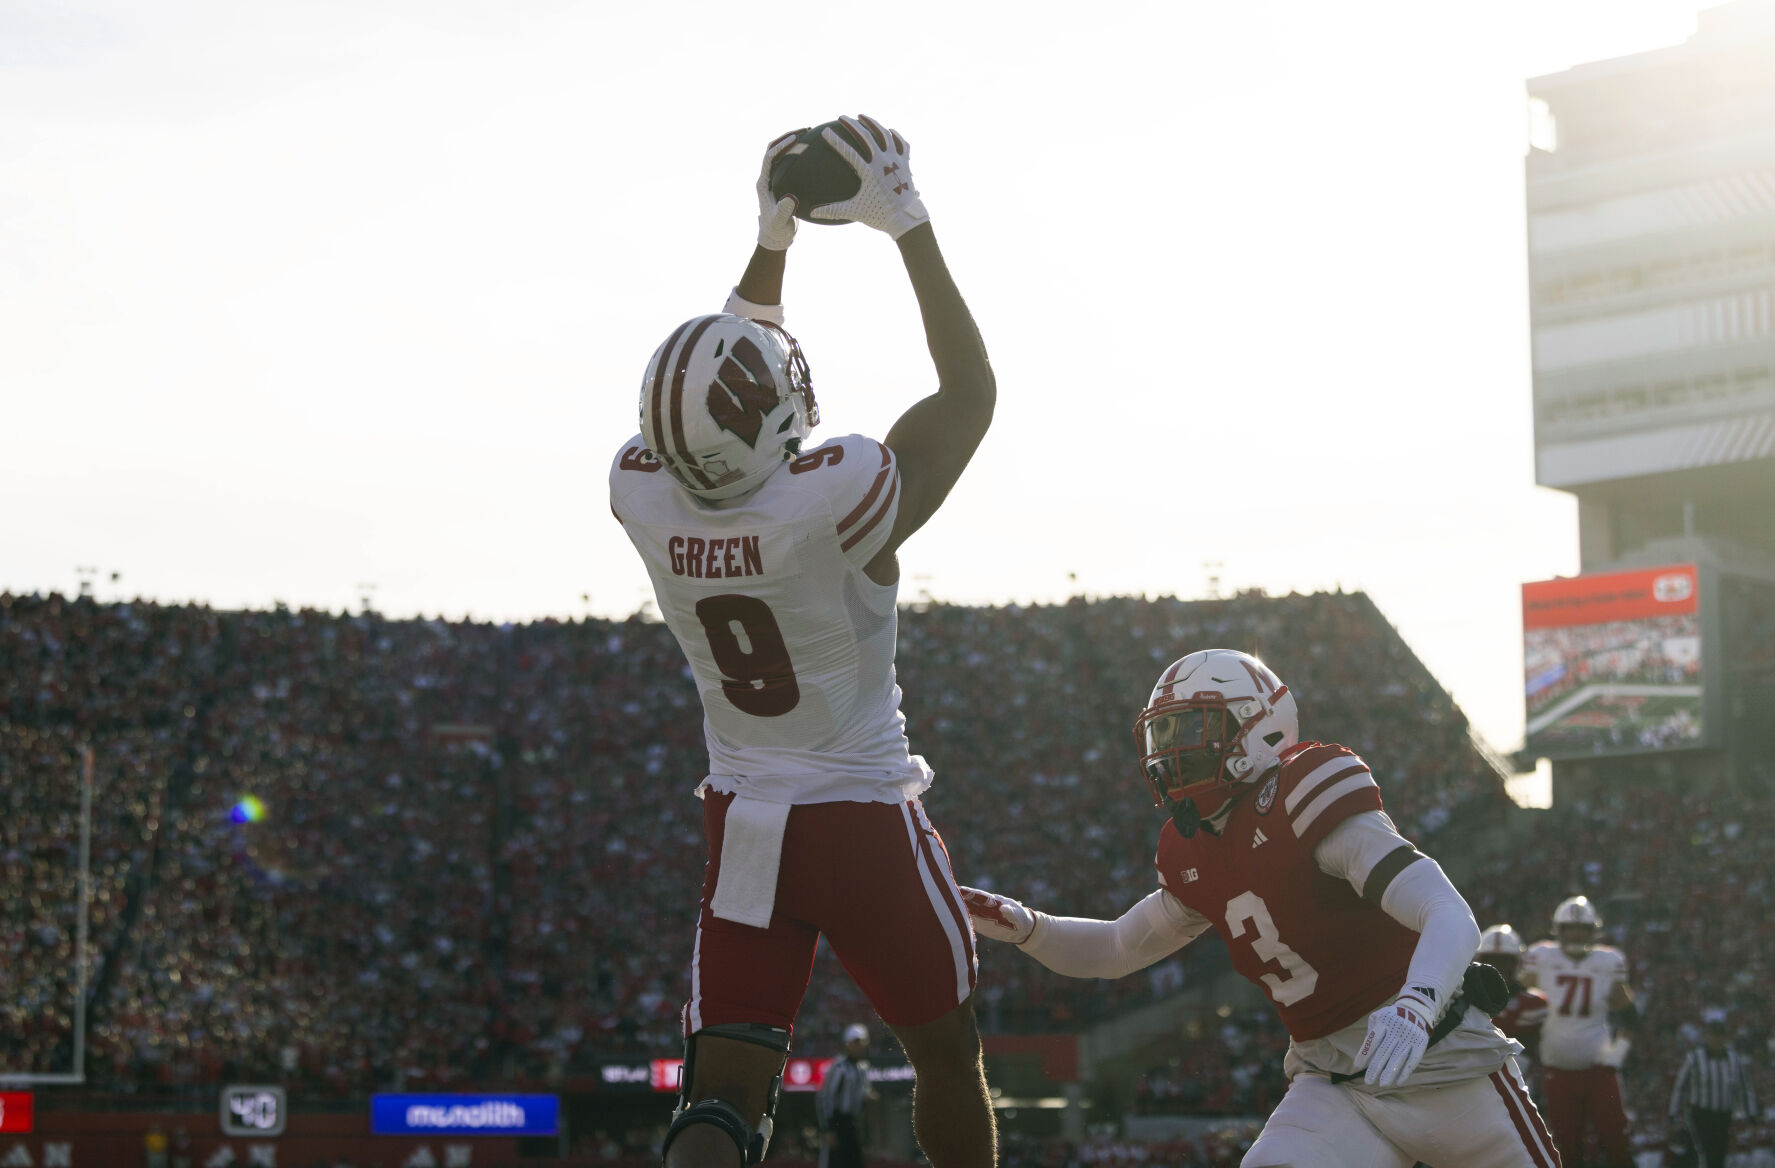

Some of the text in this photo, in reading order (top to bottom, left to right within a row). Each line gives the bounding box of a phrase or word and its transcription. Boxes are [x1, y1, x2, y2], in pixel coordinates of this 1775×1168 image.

[789, 444, 844, 475] 9
[668, 535, 764, 579] GREEN
[695, 593, 801, 718] 9
[1224, 889, 1320, 1008] 3
[1555, 974, 1594, 1018] 71
